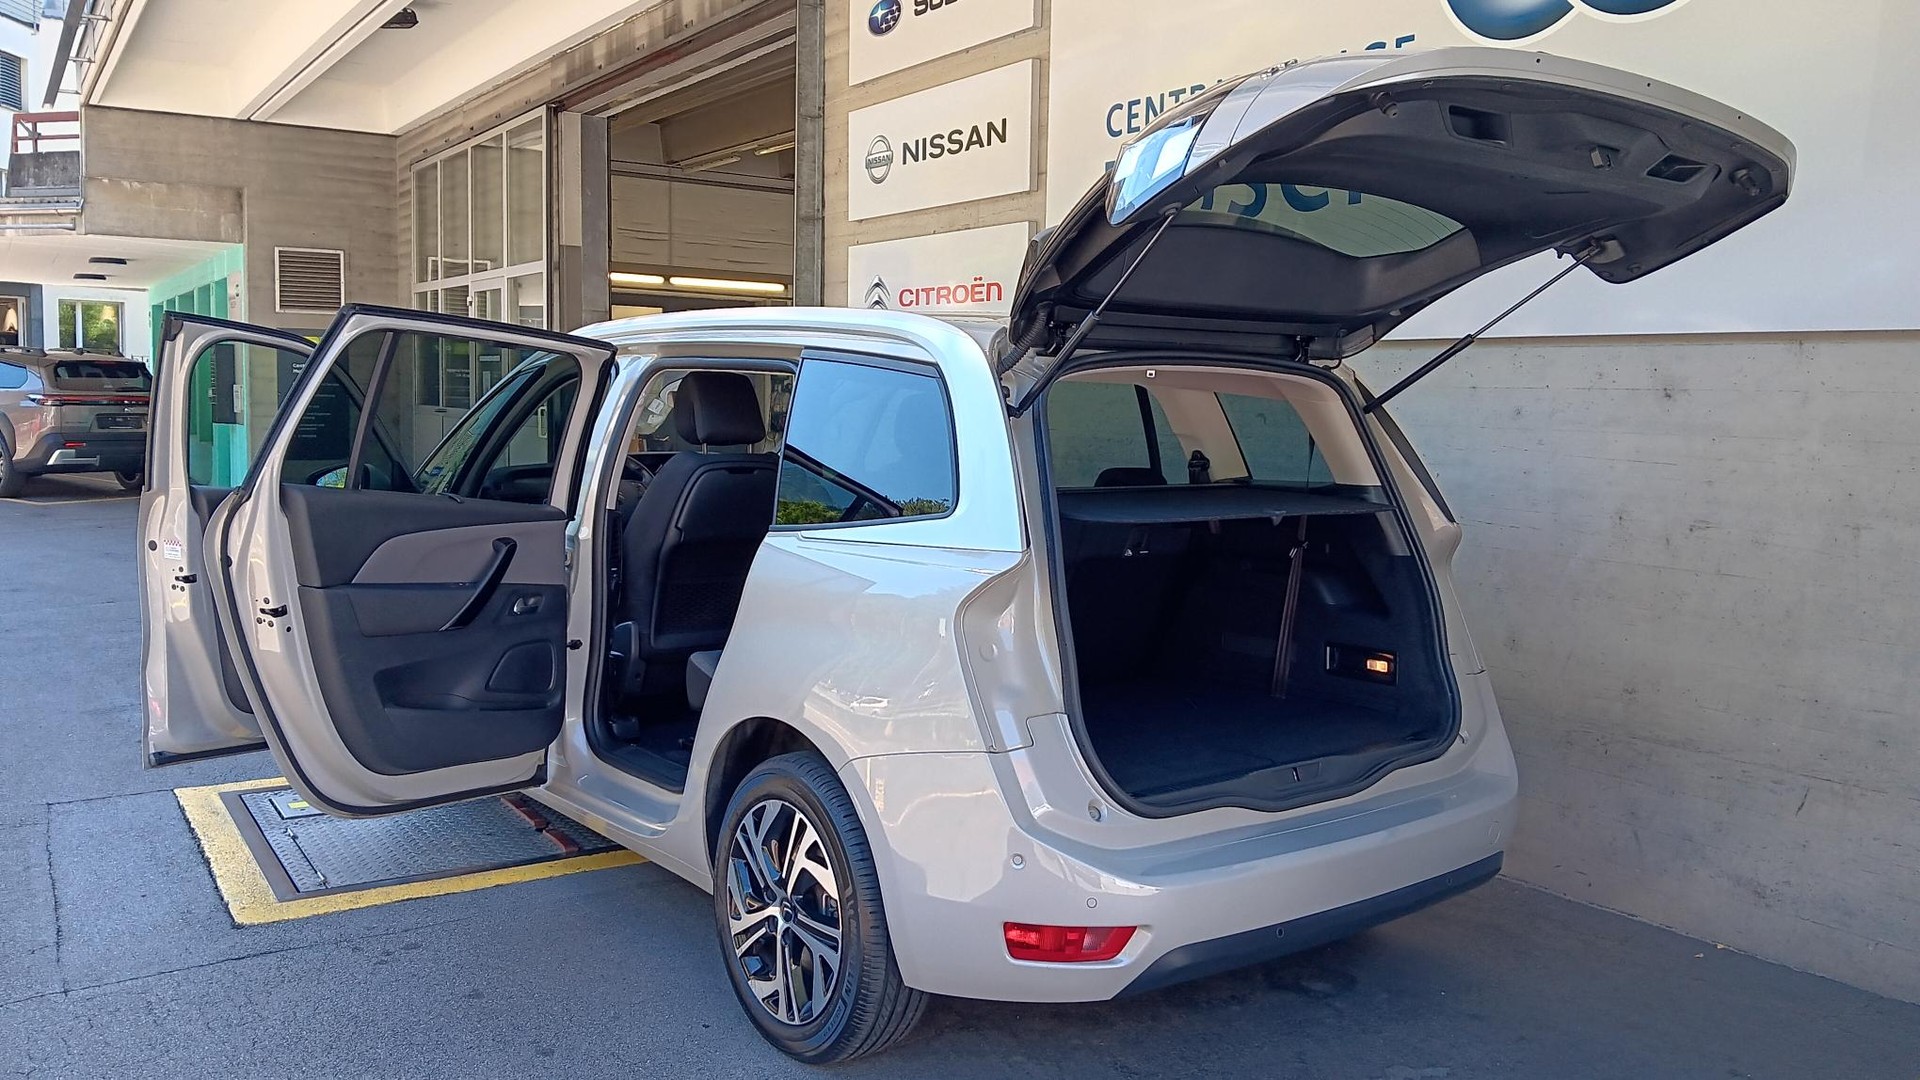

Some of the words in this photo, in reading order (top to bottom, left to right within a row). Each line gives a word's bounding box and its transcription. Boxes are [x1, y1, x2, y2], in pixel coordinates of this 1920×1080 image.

[902, 118, 1007, 165] NISSAN
[868, 154, 890, 165] NISSAN
[898, 276, 1002, 307] CITROËN
